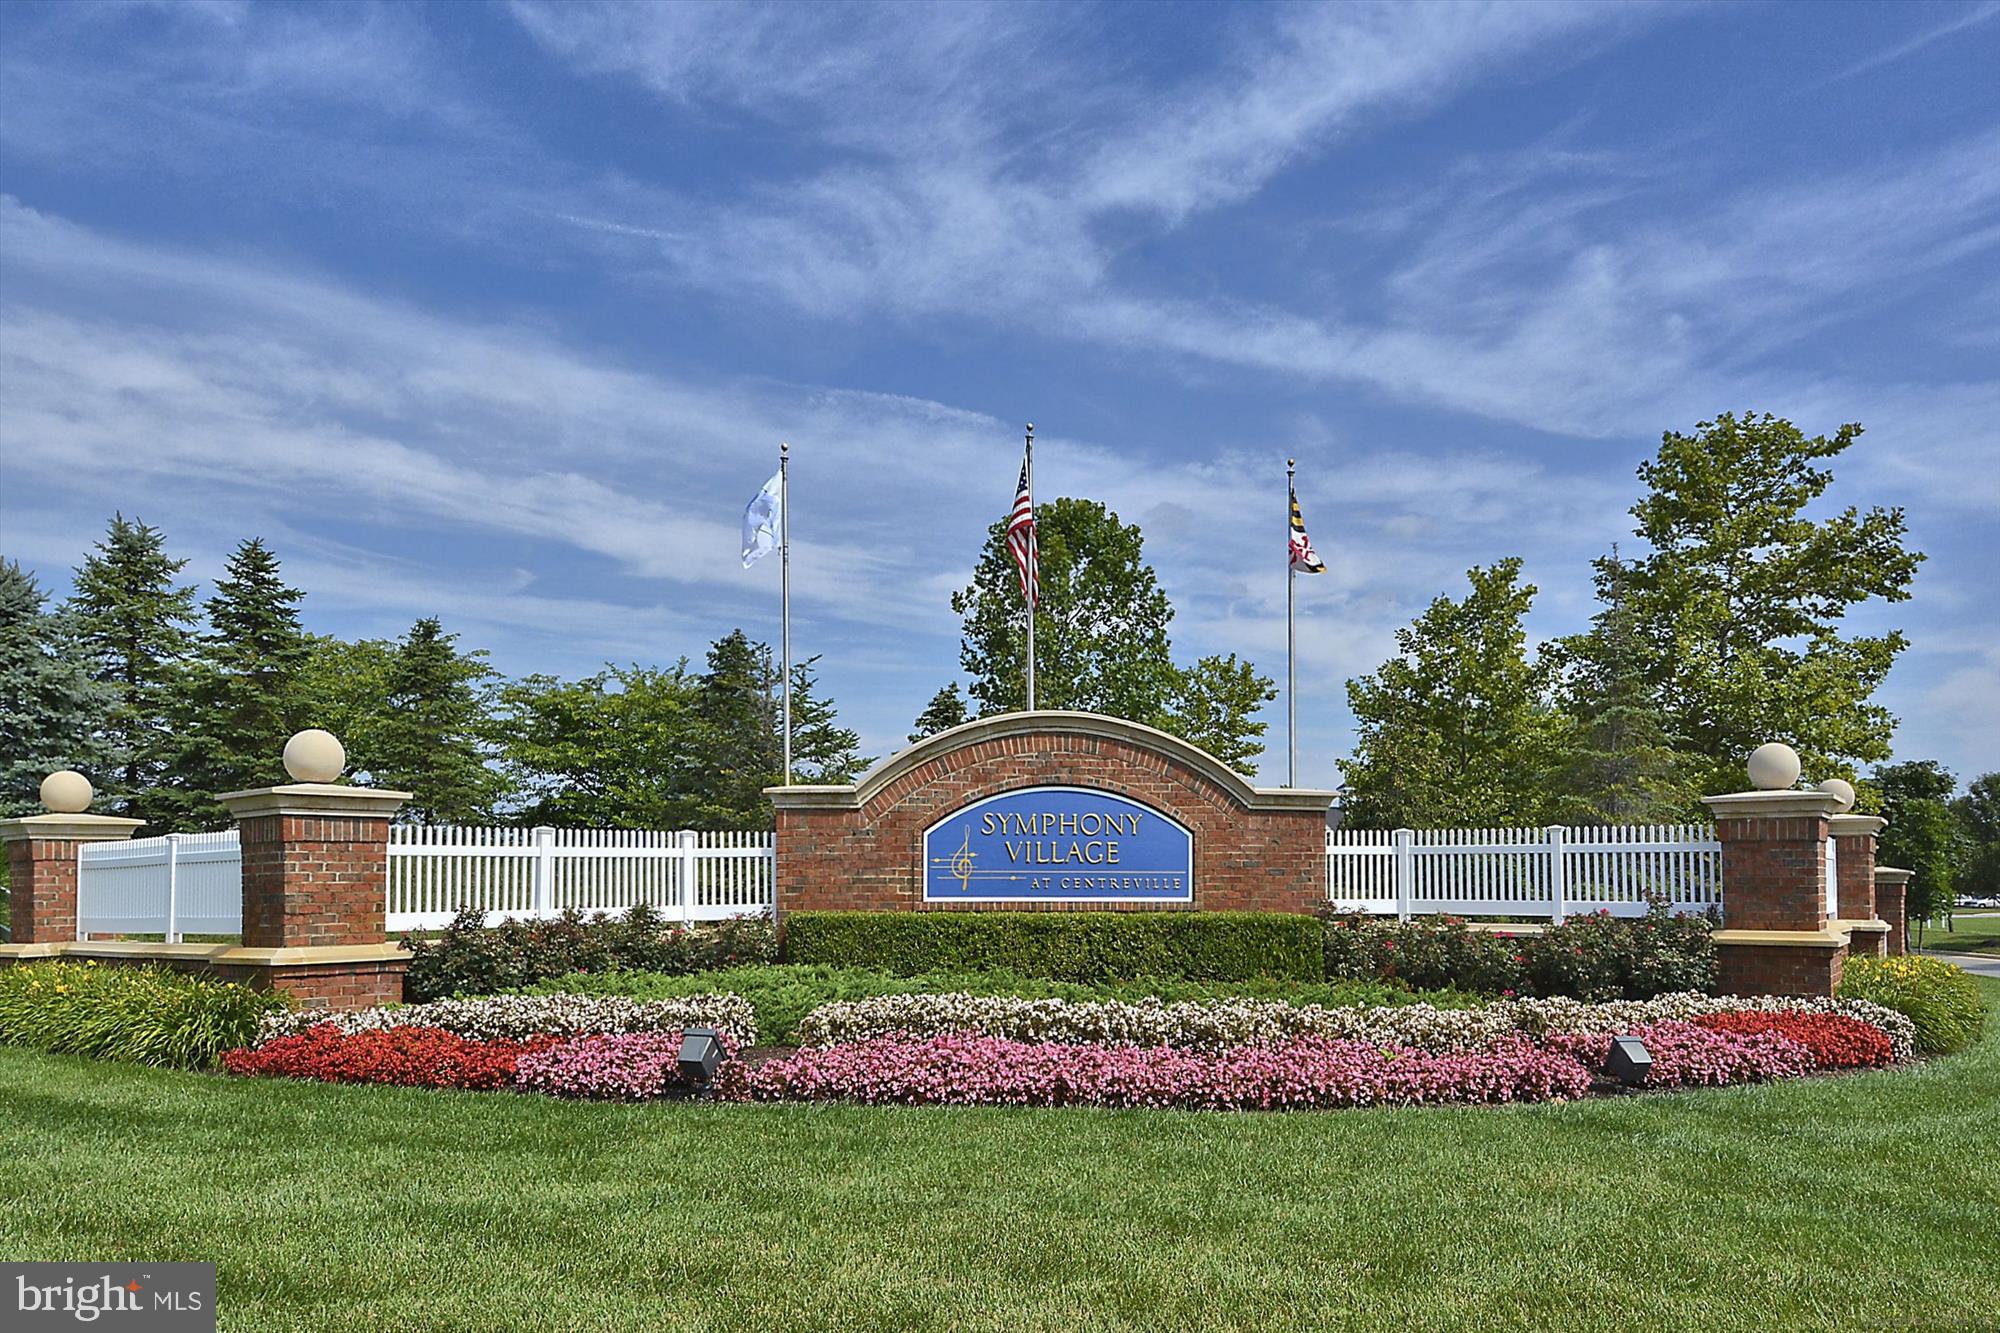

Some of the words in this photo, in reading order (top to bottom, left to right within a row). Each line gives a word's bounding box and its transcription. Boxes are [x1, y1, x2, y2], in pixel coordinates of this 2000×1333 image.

[981, 812, 1143, 836] SYMPHONY
[1005, 840, 1121, 865] VILLAGE
[1031, 877, 1051, 889] AT
[1060, 877, 1182, 889] CENTREVILLE
